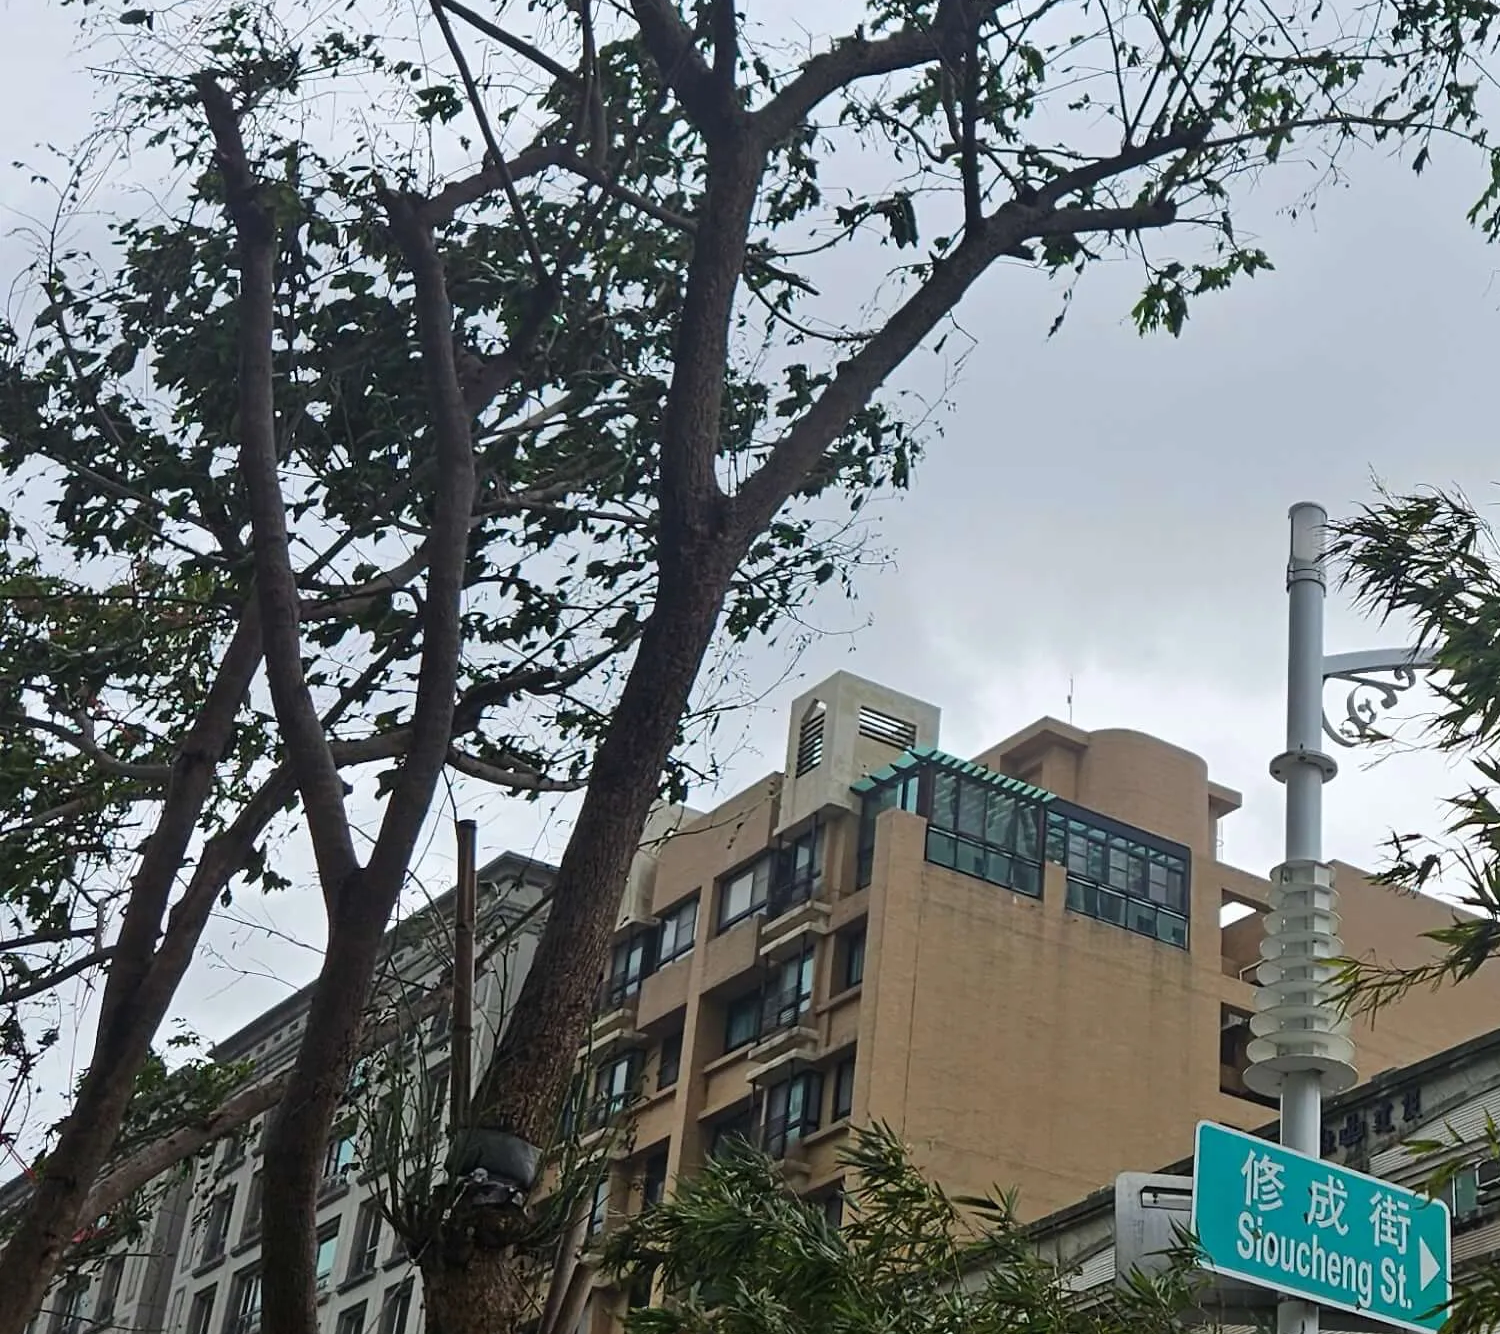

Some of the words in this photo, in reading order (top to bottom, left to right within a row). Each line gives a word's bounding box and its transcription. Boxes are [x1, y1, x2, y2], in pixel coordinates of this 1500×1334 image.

[1240, 1149, 1410, 1254] 修成街
[1238, 1211, 1372, 1308] Sioucheng
[1380, 1256, 1412, 1308] St.
